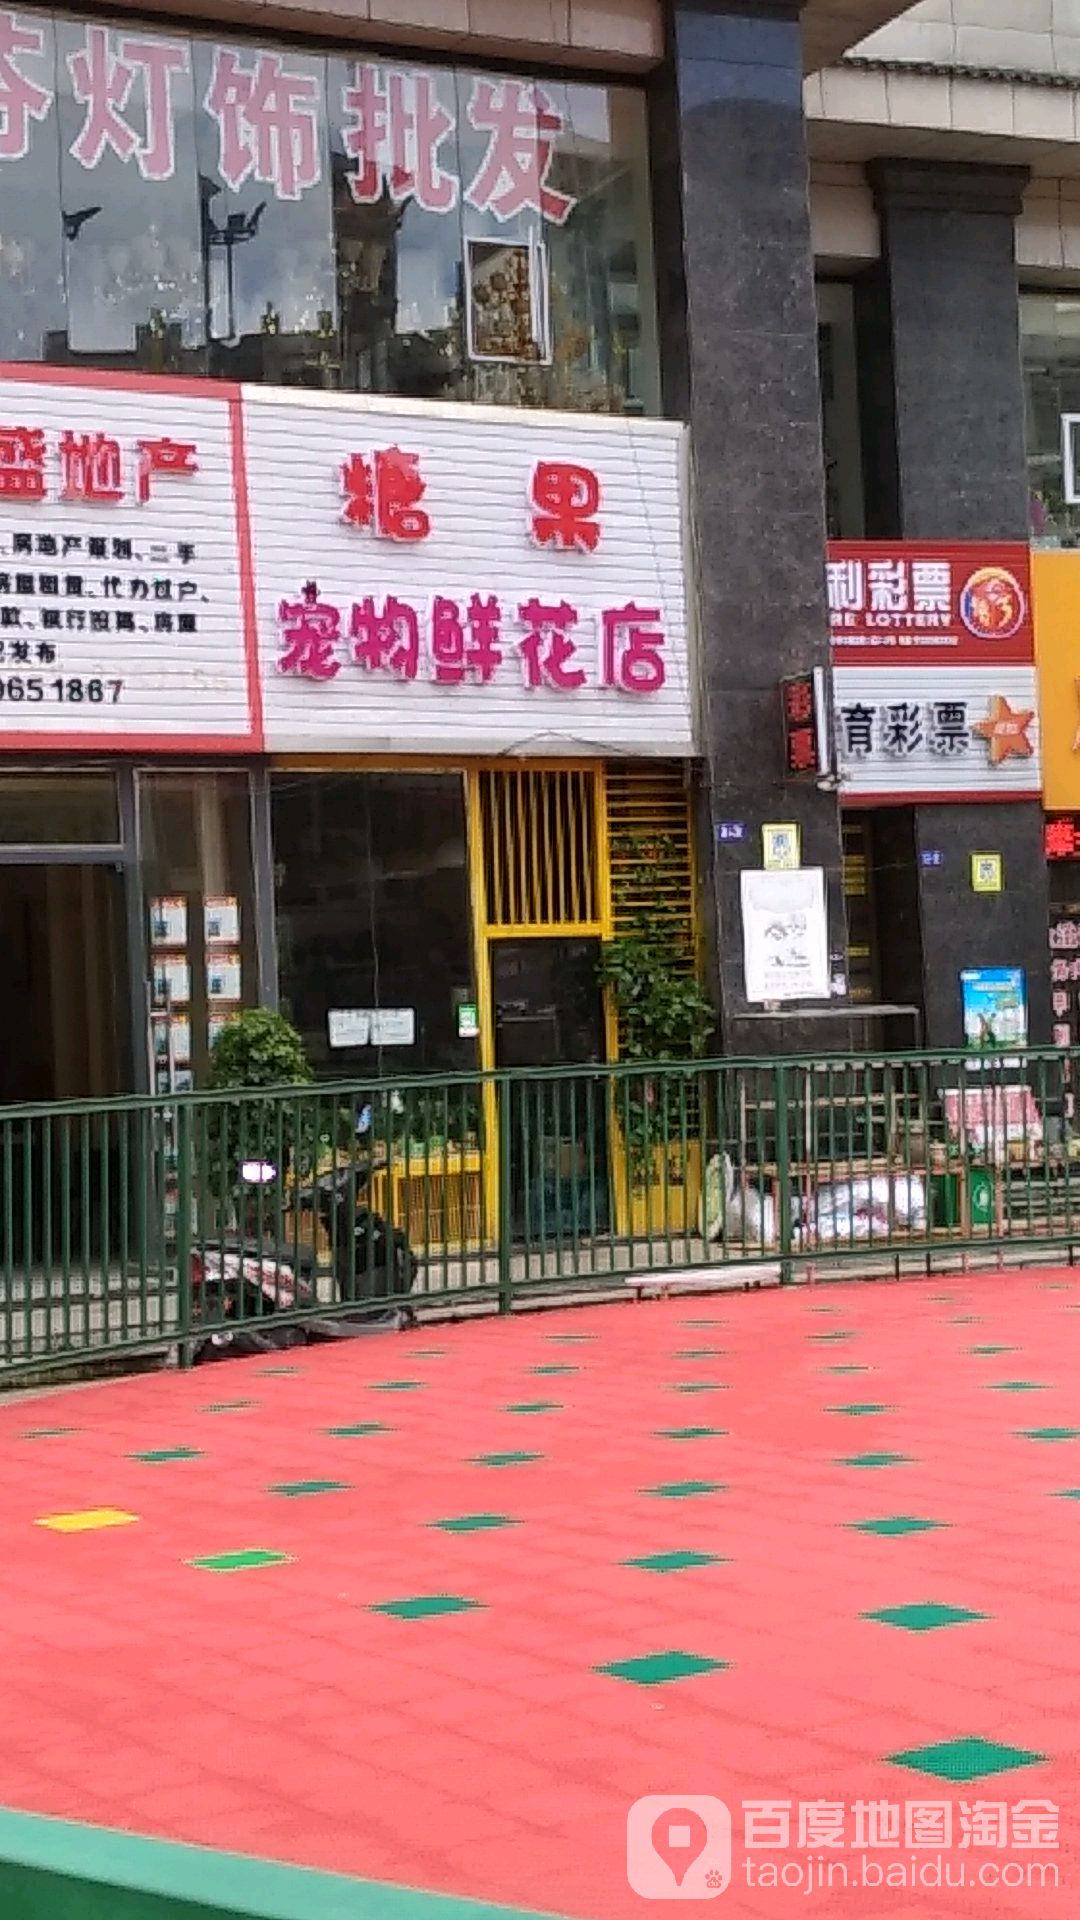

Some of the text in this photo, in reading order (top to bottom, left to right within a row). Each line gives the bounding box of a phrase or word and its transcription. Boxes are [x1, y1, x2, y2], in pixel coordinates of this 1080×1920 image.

[825, 559, 951, 611] 利彩票
[277, 582, 666, 692] 宠物鲜花店
[865, 612, 951, 627] LOTTERY
[0, 640, 57, 663] 发布
[841, 702, 969, 753] 育彩票
